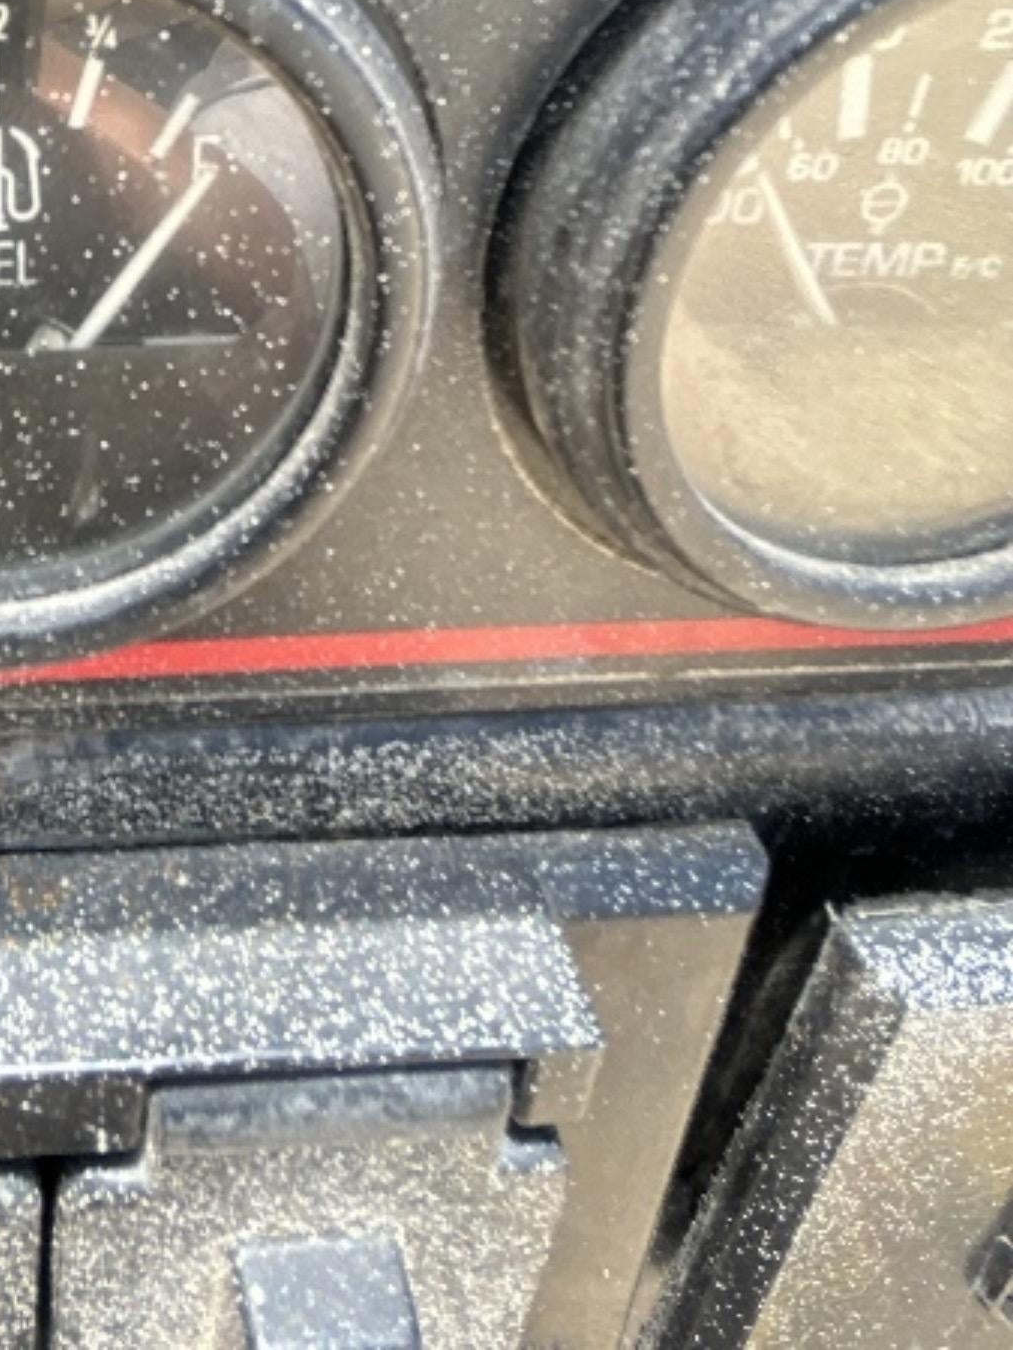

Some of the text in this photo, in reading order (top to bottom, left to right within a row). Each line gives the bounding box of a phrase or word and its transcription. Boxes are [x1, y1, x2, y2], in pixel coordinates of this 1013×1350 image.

[192, 134, 221, 183] F
[787, 152, 839, 181] 60
[877, 137, 931, 166] 80
[807, 241, 948, 277] TEMP
